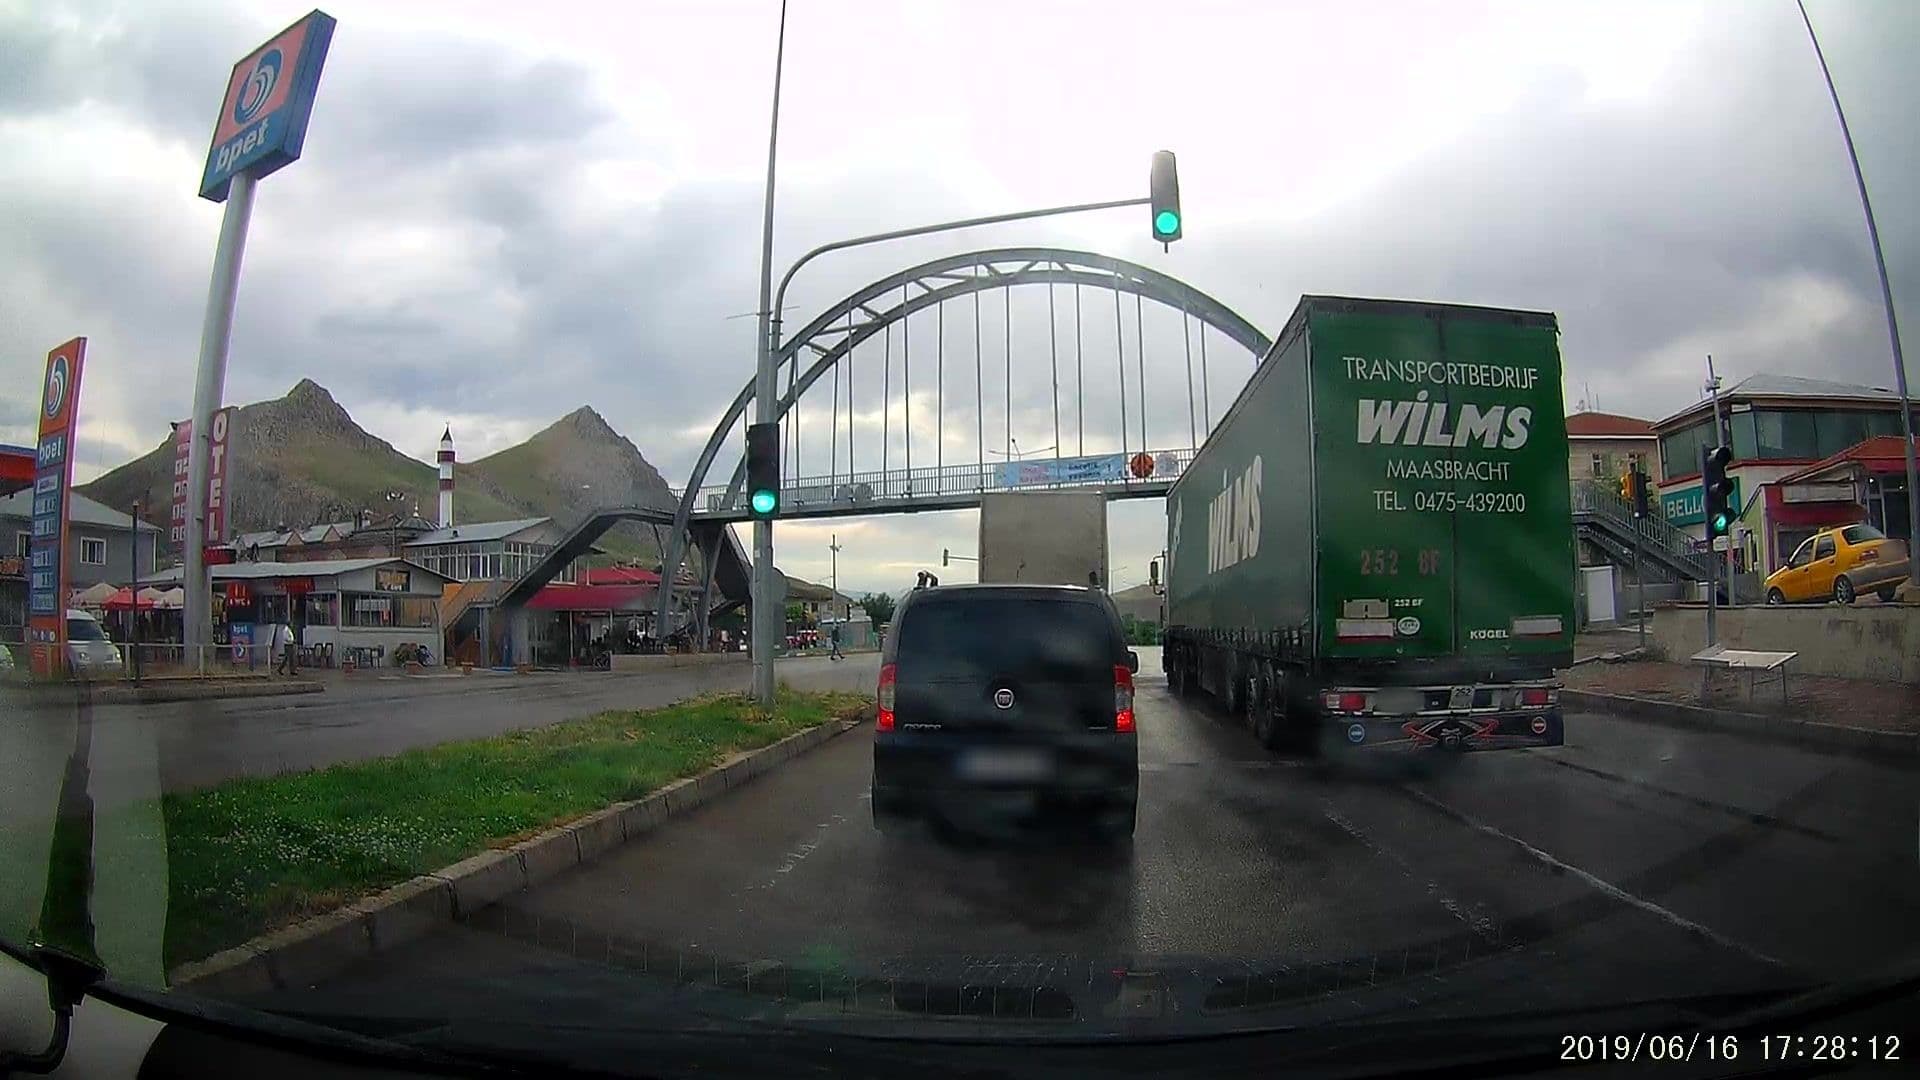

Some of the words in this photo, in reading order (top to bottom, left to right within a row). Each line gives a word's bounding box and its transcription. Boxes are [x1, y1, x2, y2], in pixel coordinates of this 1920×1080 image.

[215, 120, 270, 173] bpet
[1342, 356, 1539, 390] TRANSPORTBEDRIJF
[38, 436, 63, 466] bpet
[208, 412, 227, 542] OTEL
[1386, 460, 1511, 481] MAASBRACHT
[1373, 491, 1407, 511] TEL.
[1415, 492, 1526, 513] 0475-439200
[1360, 549, 1398, 576] 252
